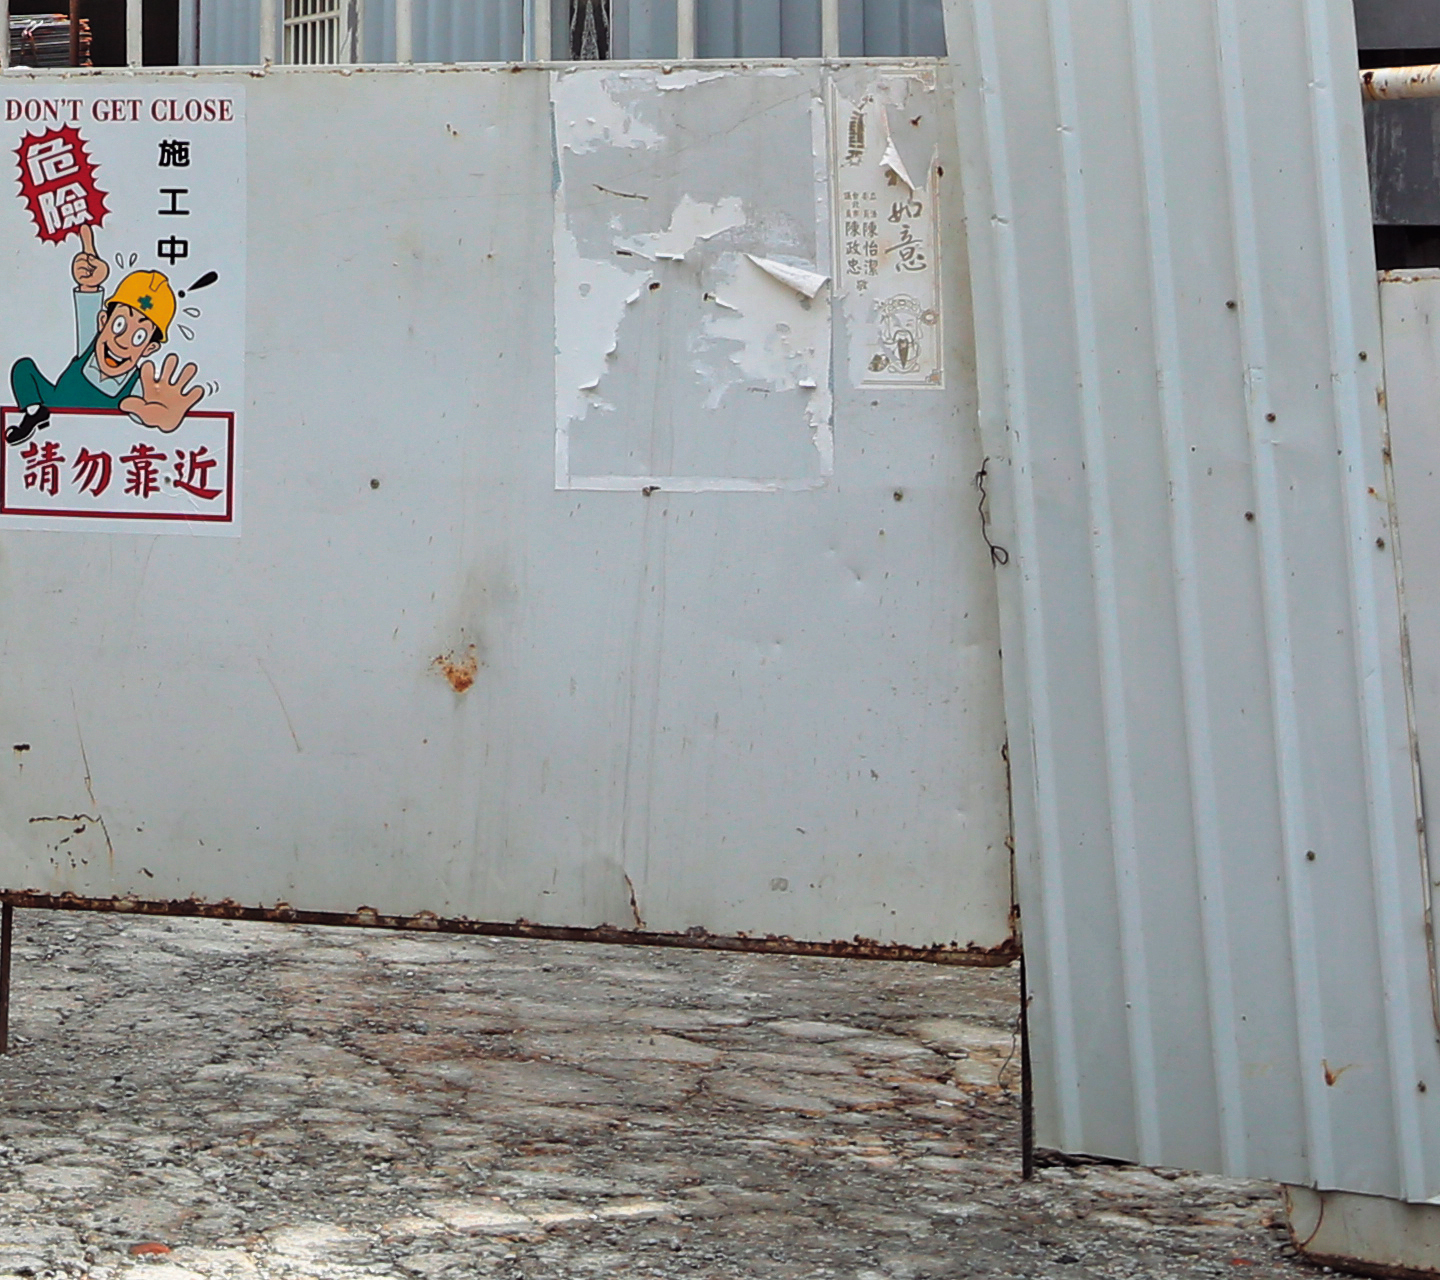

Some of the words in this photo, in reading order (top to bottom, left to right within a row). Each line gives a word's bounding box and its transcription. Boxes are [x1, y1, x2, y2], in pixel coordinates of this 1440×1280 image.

[5, 99, 83, 122] DON'T
[92, 99, 143, 122] GET
[151, 99, 234, 122] CLOSE
[26, 137, 92, 235] 危險
[158, 139, 190, 265] 施工中
[885, 169, 927, 272] 如意
[20, 443, 223, 500] 請勿靠近
